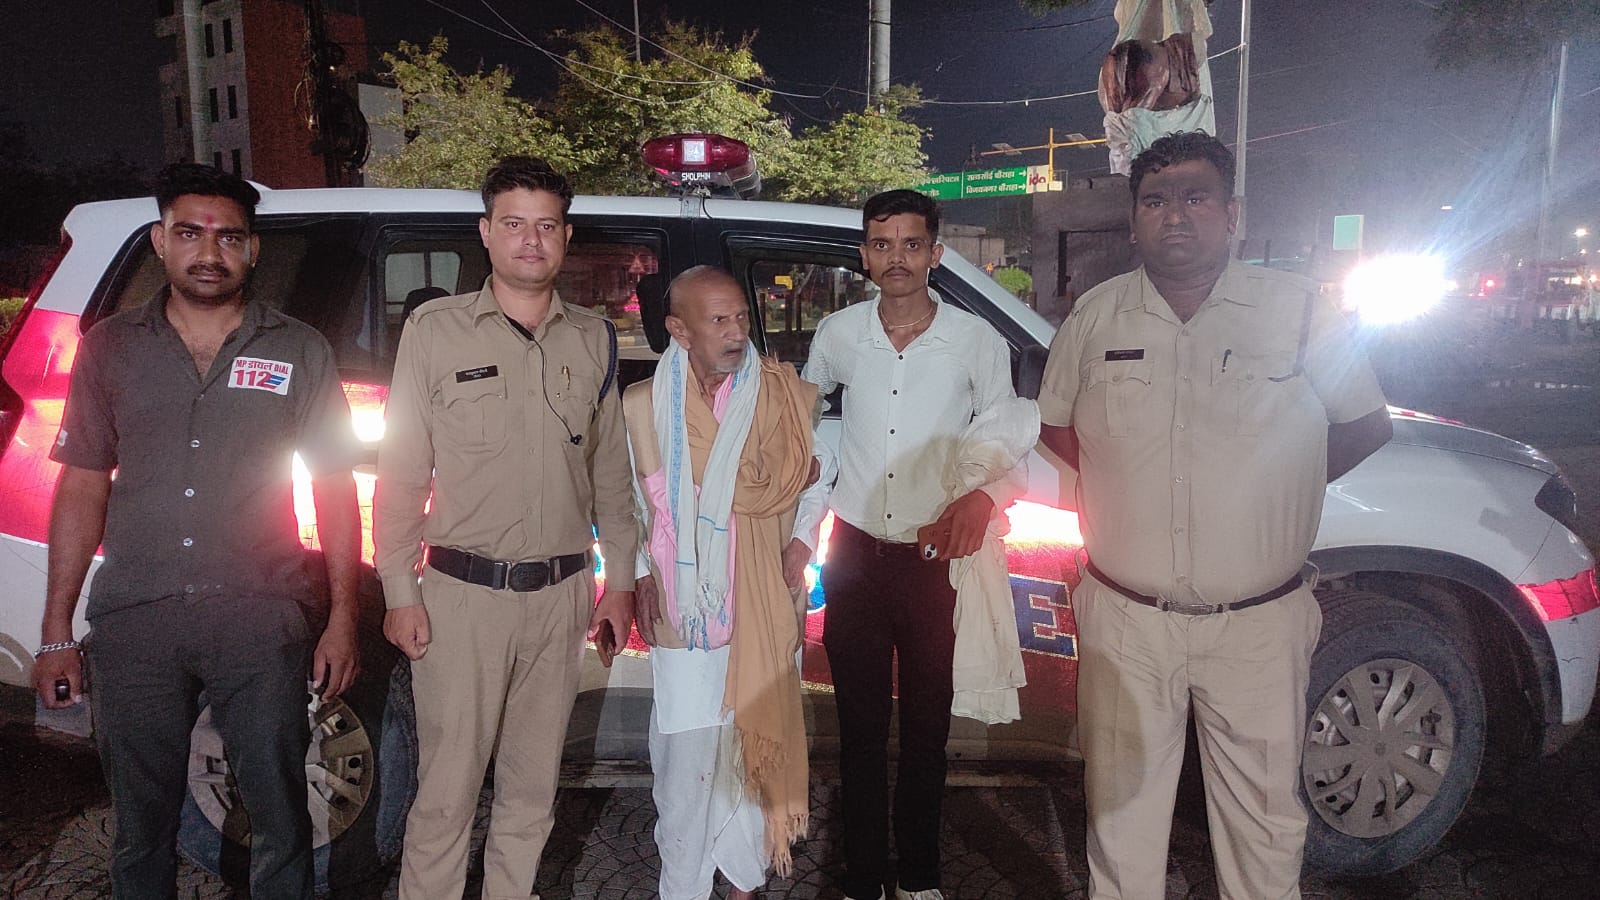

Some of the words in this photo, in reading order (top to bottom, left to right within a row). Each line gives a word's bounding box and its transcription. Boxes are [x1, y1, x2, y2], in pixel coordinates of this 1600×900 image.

[1029, 173, 1046, 186] ida
[235, 360, 247, 368] MP
[248, 361, 273, 371] डायल
[274, 364, 289, 375] DIAL
[234, 369, 277, 390] 112
